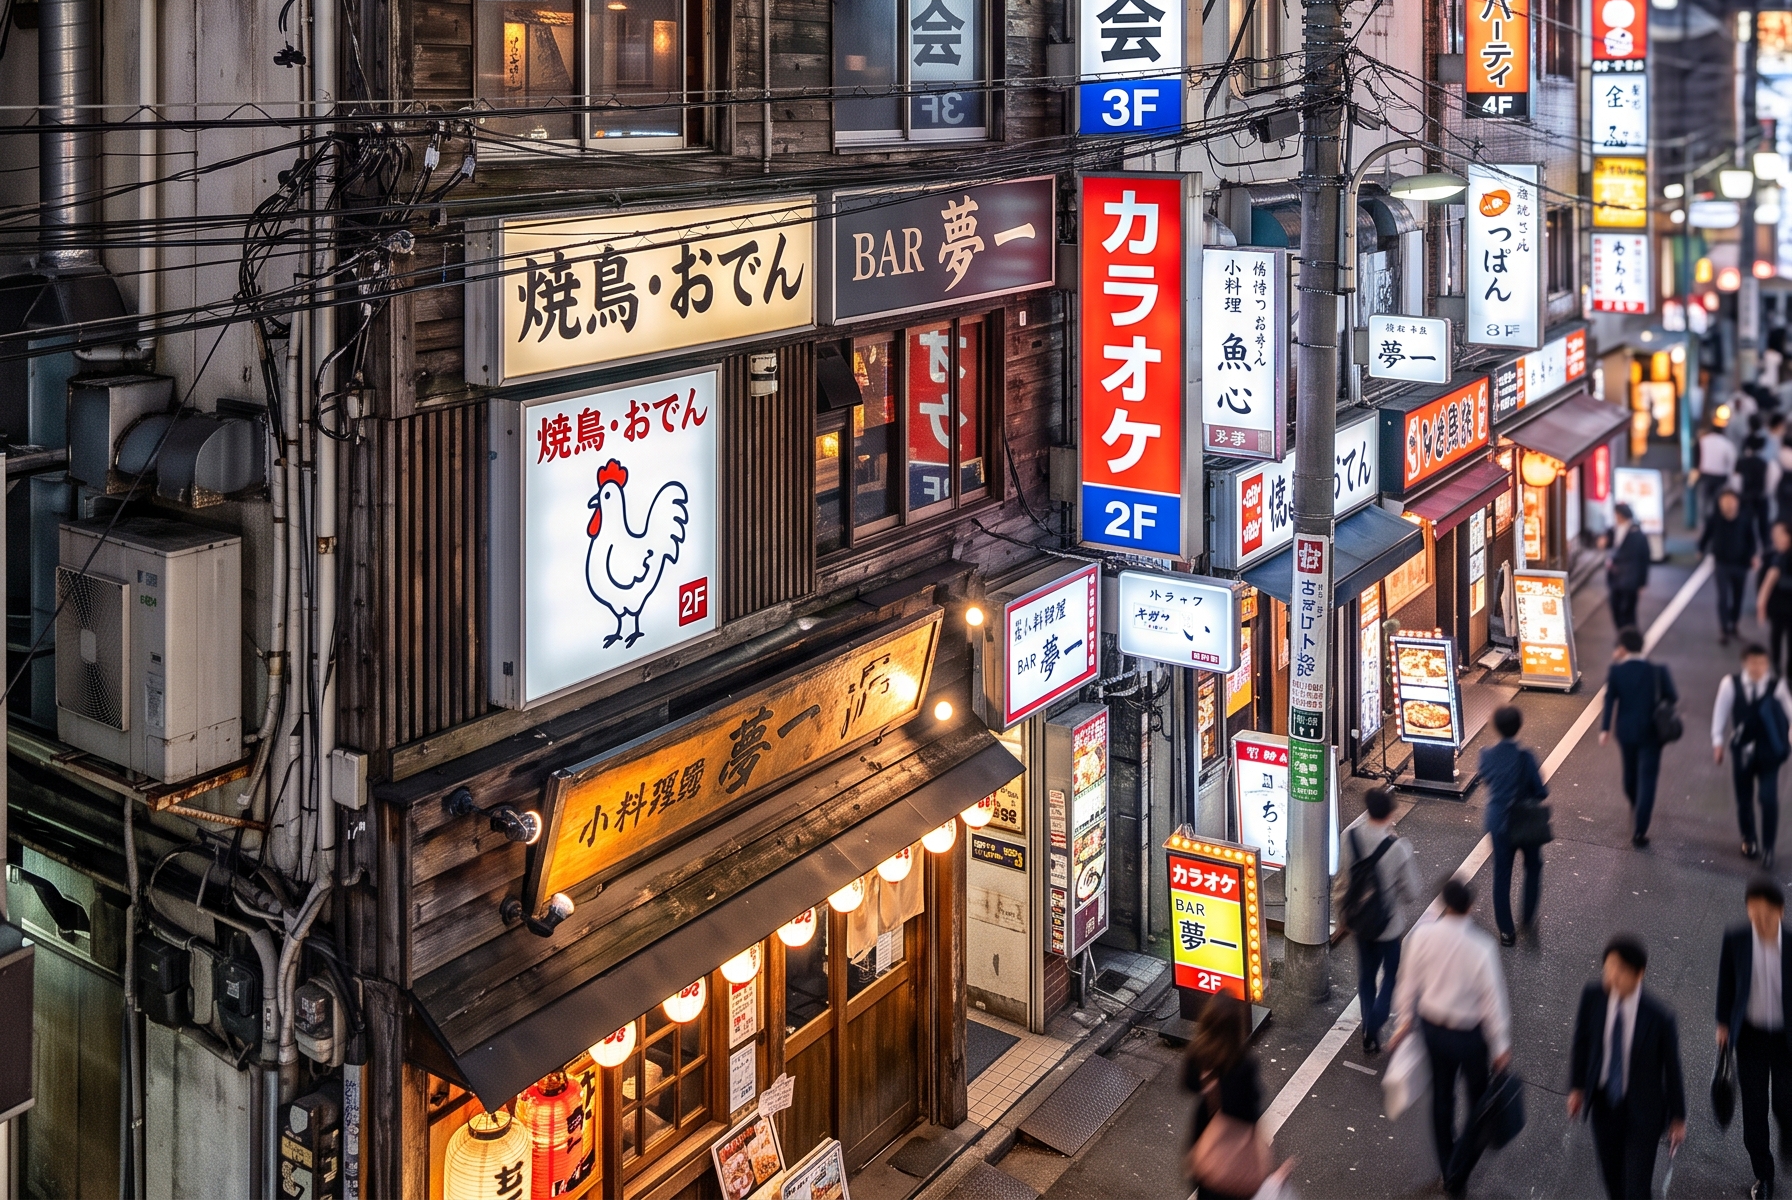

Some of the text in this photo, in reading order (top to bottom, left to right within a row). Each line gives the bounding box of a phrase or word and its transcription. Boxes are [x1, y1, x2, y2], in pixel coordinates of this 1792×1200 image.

[1102, 88, 1159, 127] 3F
[1482, 96, 1514, 114] 4F
[852, 194, 1036, 292] BAR 夢一
[517, 231, 805, 344] 焼鳥・おでん
[1225, 259, 1242, 313] 小料理
[1101, 190, 1162, 474] カラオケ
[1217, 333, 1252, 415] 魚心
[1378, 340, 1436, 369] 夢一
[537, 388, 708, 465] 焼鳥・おでん
[1104, 501, 1158, 540] 2F
[682, 586, 706, 618] 2F
[1018, 634, 1083, 682] BAR 夢一
[1173, 865, 1236, 895] カラオケ
[1176, 899, 1205, 916] BAR
[1179, 920, 1237, 950] 夢一
[1198, 973, 1222, 991] 2F
